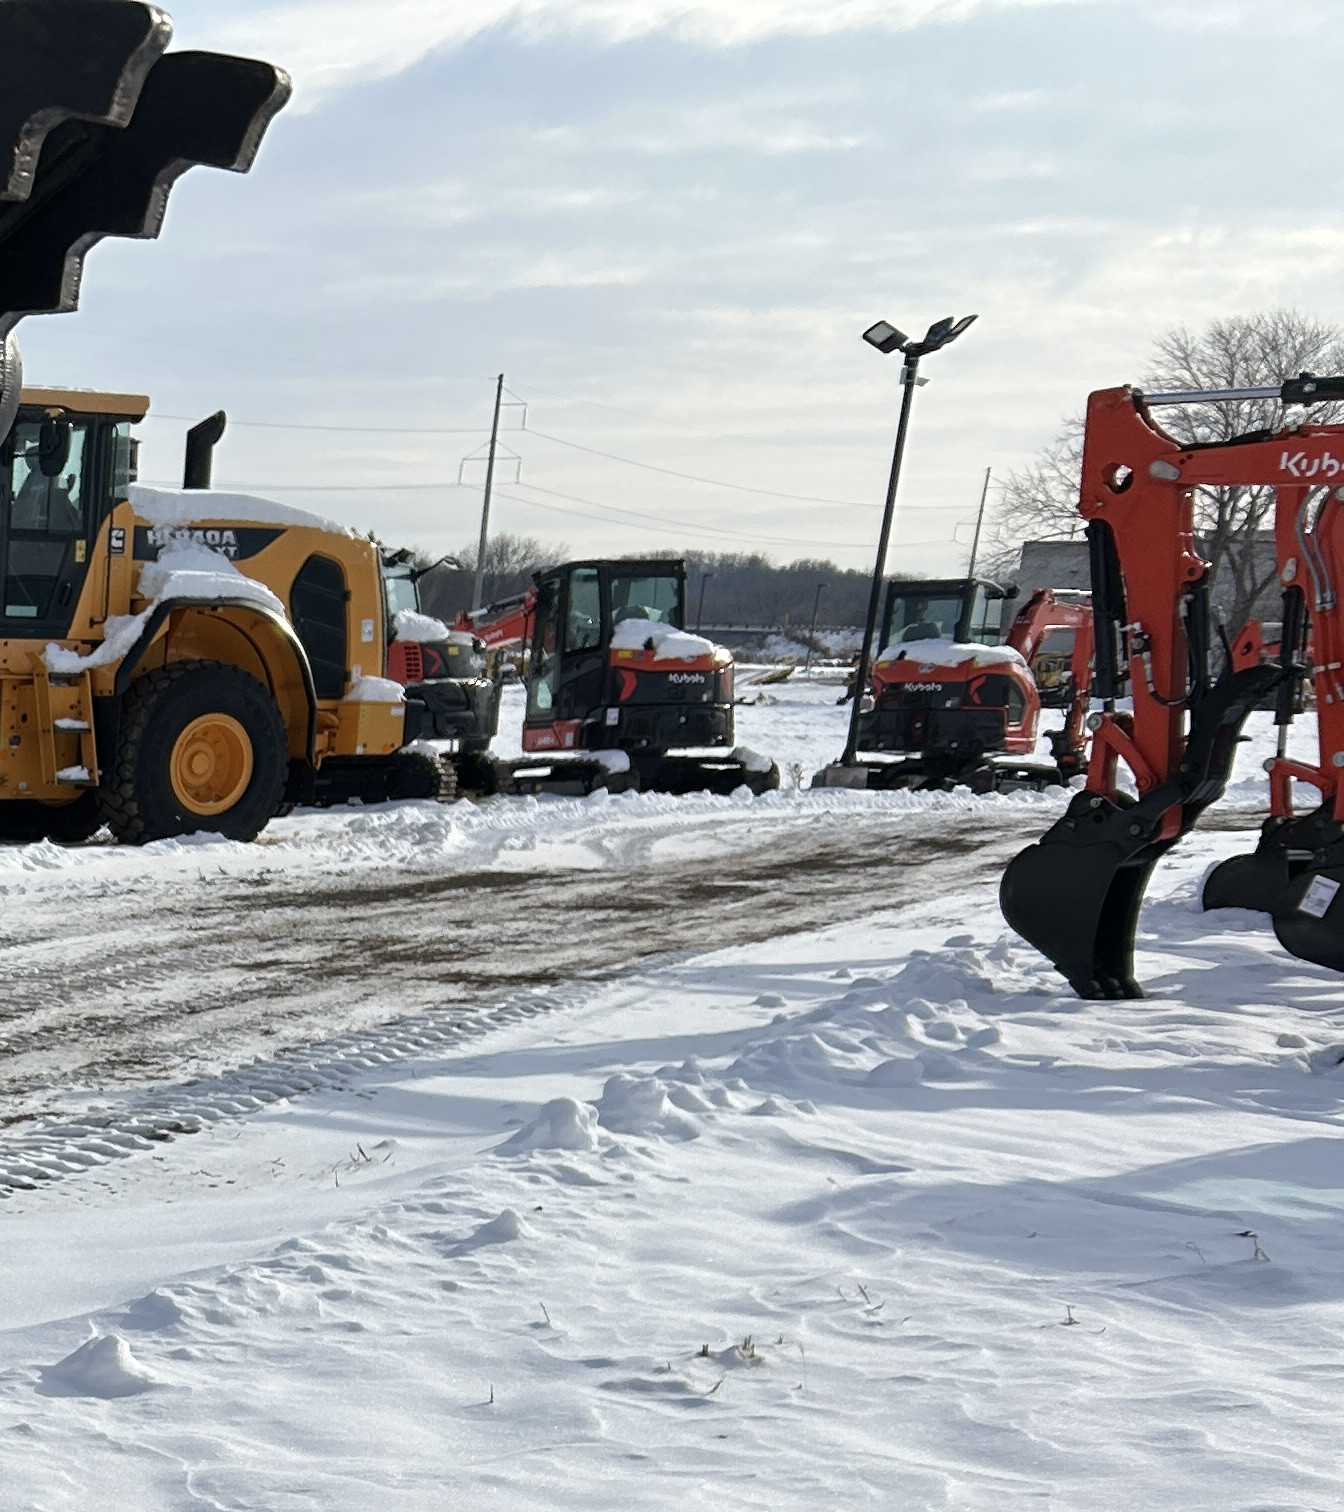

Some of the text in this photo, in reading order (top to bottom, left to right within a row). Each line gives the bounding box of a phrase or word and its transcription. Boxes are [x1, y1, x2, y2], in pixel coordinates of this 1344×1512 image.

[1280, 451, 1344, 477] Kub
[668, 672, 706, 684] Kubota
[903, 682, 942, 692] Kubota
